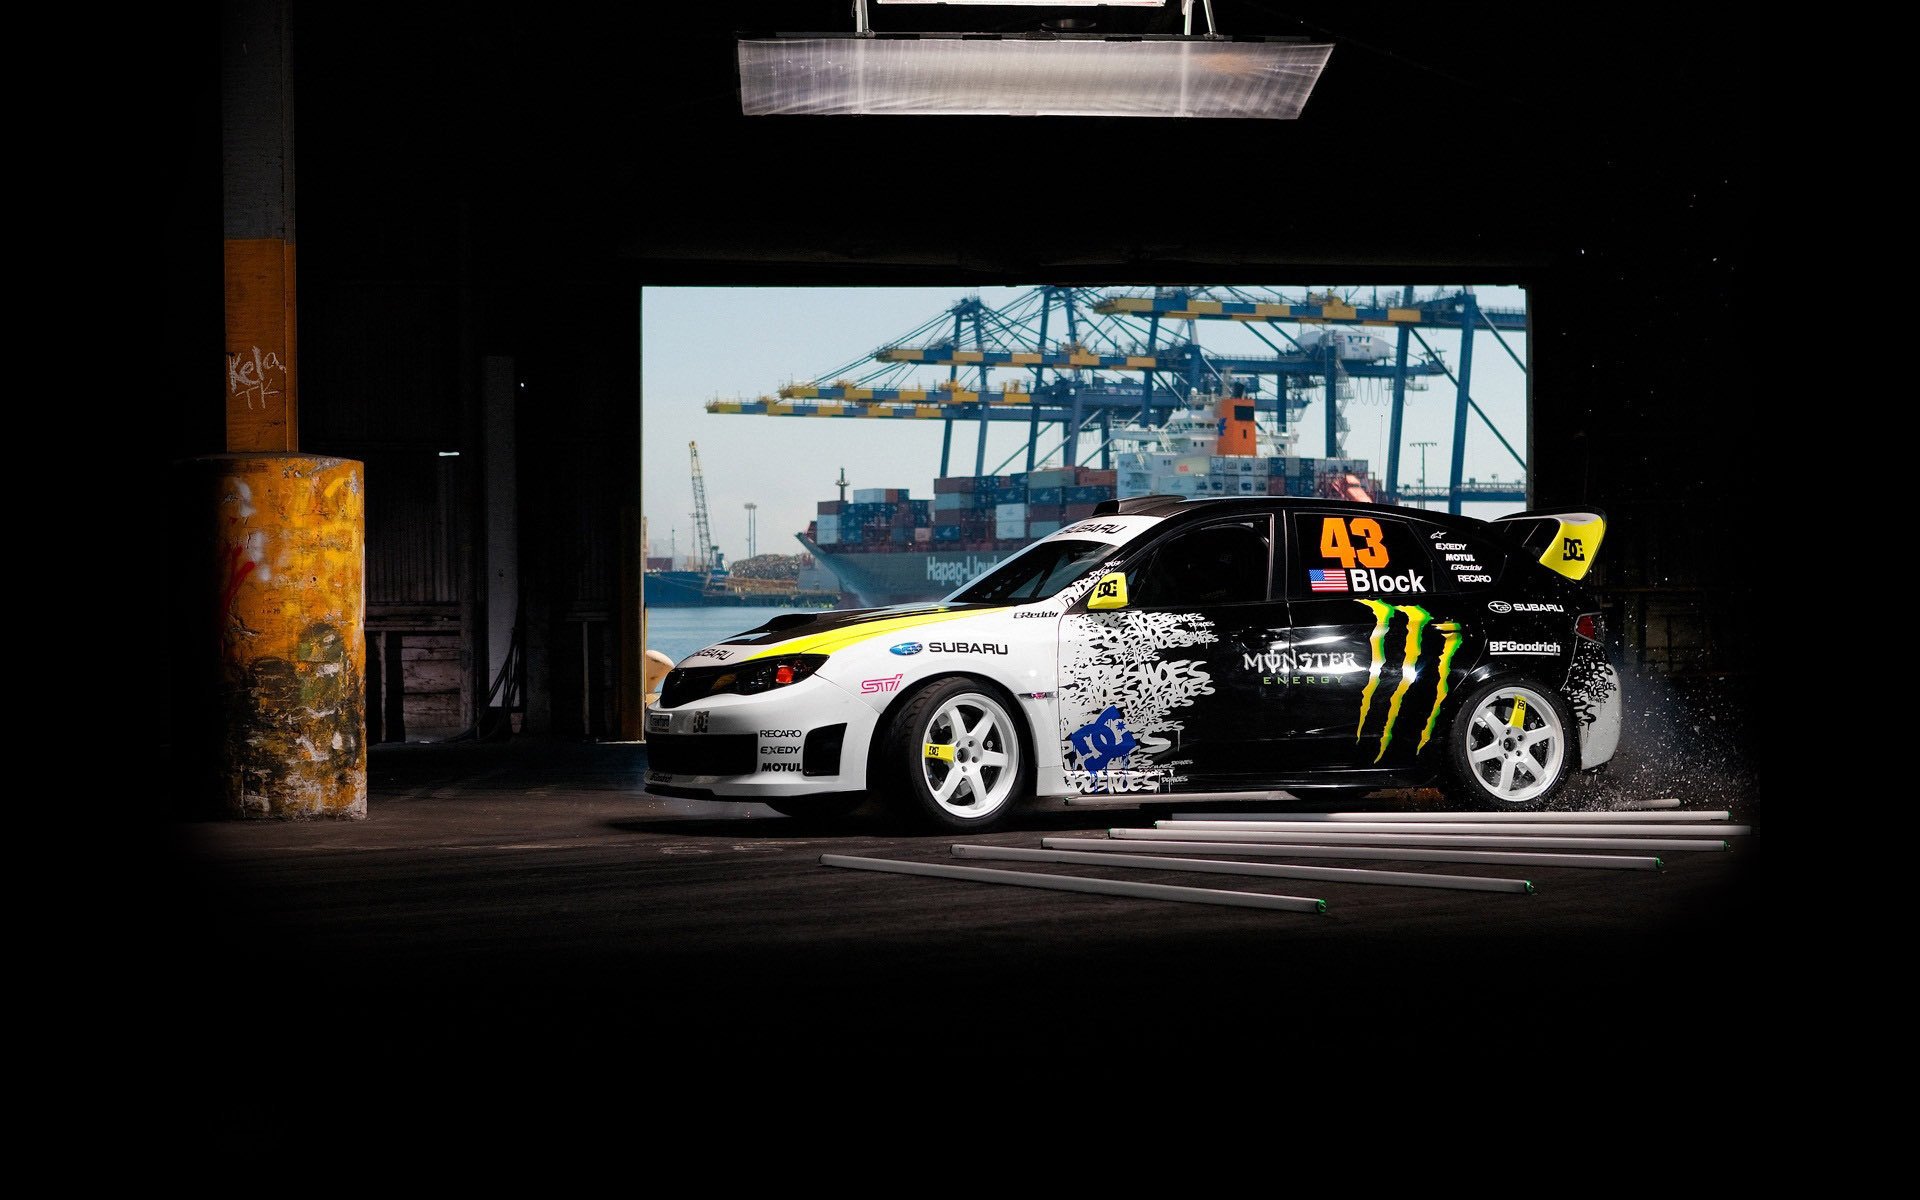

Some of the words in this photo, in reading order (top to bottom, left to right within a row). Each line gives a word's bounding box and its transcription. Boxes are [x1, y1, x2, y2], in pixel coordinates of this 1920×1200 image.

[1320, 518, 1389, 568] 43
[1446, 553, 1475, 562] MOTUL
[1350, 569, 1426, 592] Block
[1458, 574, 1491, 583] RECARO
[1513, 603, 1564, 613] SUBARU
[928, 642, 1009, 656] SUBARU
[1489, 641, 1561, 653] BFGoodrich
[1263, 675, 1343, 685] ENERGY
[759, 729, 802, 738] RECARO
[760, 745, 801, 755] EXEDY
[761, 762, 802, 772] MOTUL
